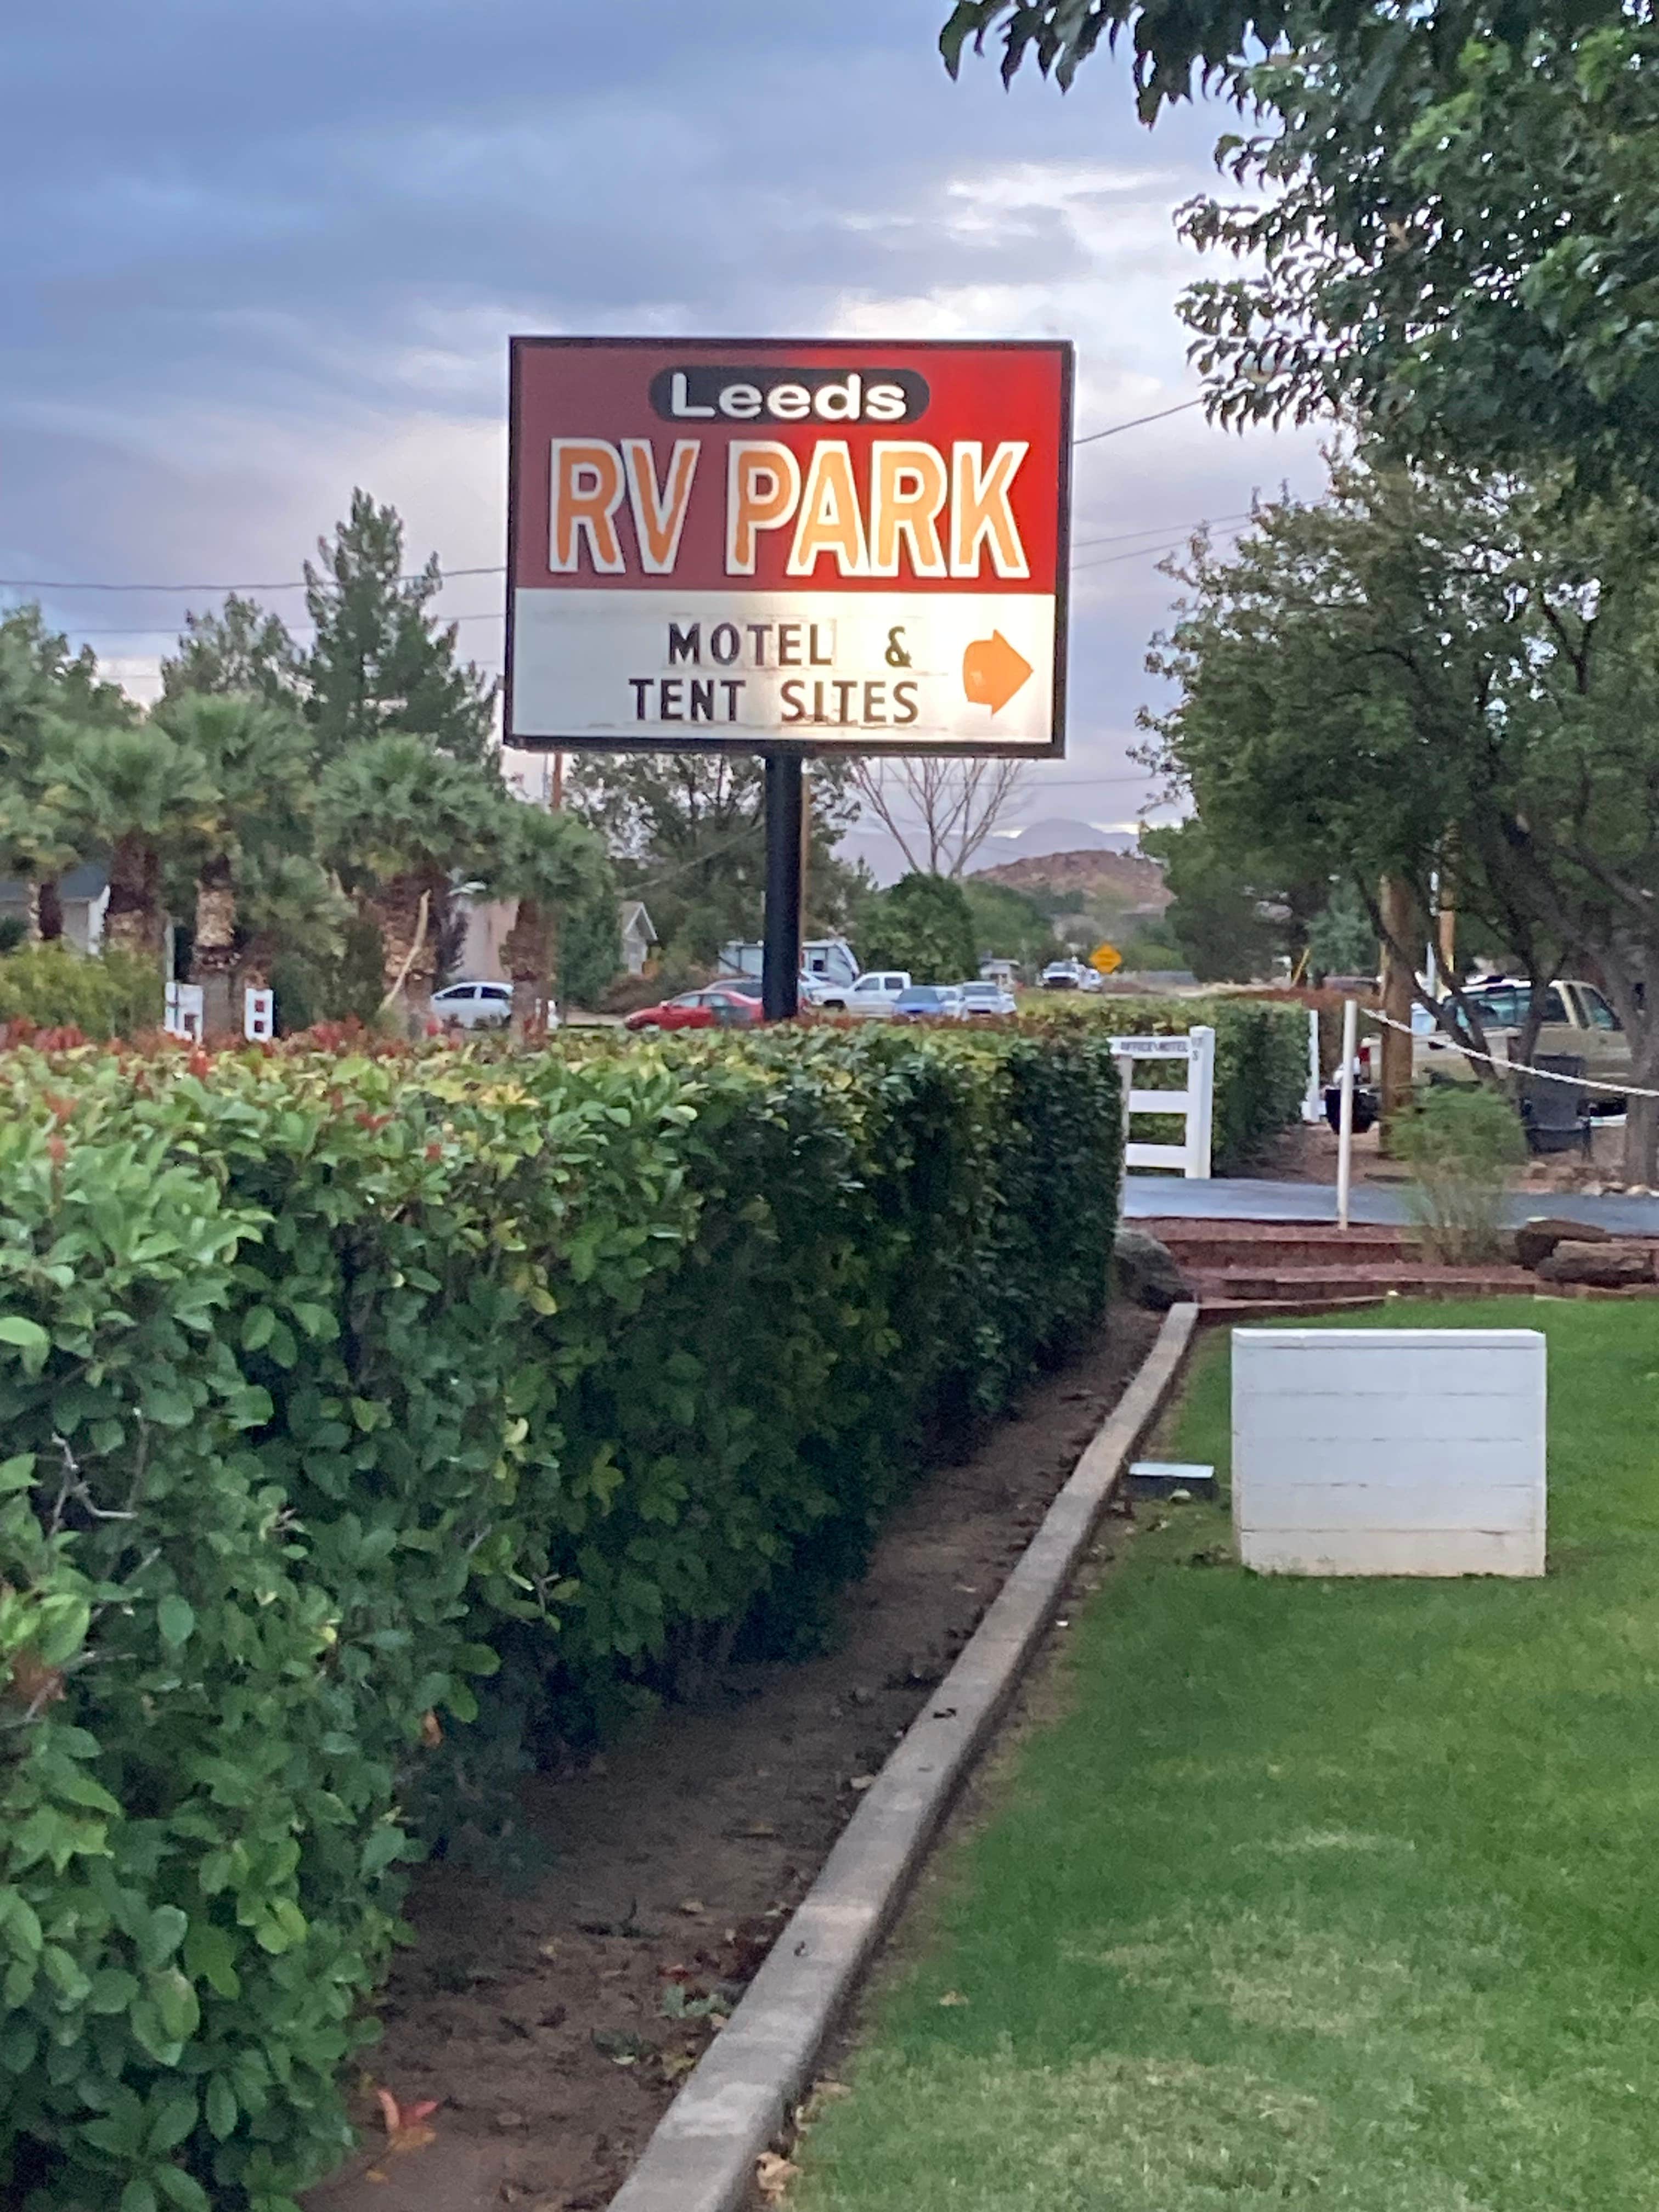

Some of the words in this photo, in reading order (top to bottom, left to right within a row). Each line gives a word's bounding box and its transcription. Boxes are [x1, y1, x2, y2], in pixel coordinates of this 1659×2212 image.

[671, 373, 907, 421] Leeds
[550, 438, 701, 574] RV
[727, 439, 1030, 578] PARK
[668, 622, 832, 666] MOTEL
[885, 625, 912, 668] &
[629, 678, 746, 721] TENT
[780, 681, 919, 723] SITES
